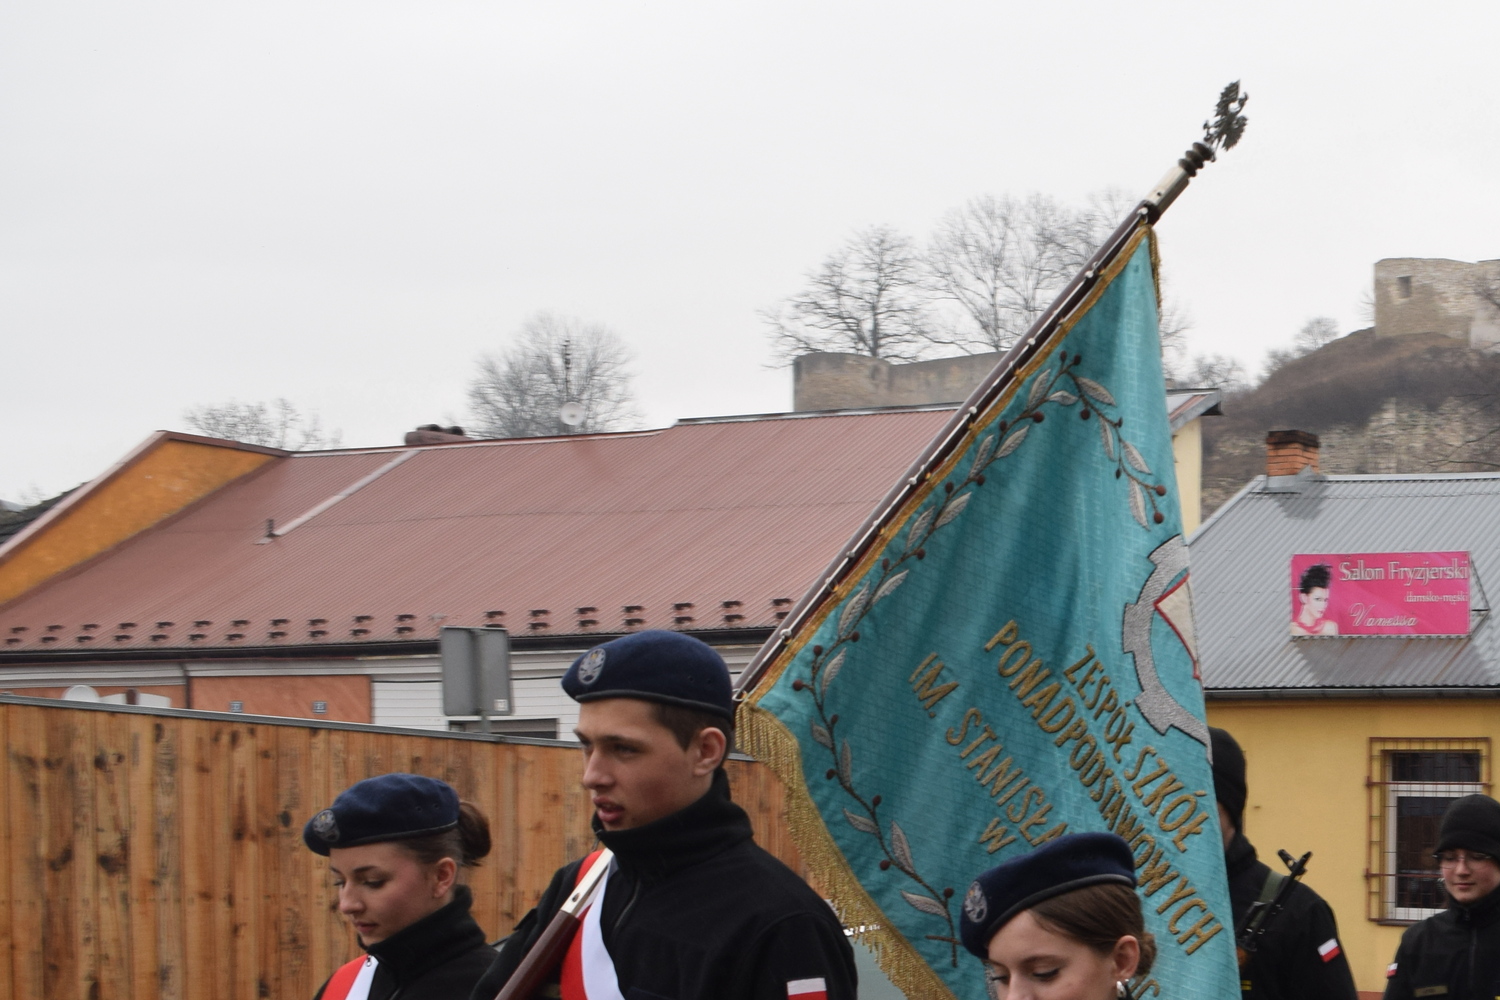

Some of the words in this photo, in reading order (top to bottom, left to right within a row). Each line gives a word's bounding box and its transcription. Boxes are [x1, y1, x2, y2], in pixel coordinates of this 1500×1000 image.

[1338, 559, 1385, 581] Salon
[1387, 558, 1469, 587] Fryzjerski
[1349, 602, 1418, 627] Vanessa
[908, 651, 959, 718] IM.
[945, 707, 1073, 847] STANISŁA
[984, 619, 1223, 956] PONADPODSTAWOWYCH
[1064, 643, 1135, 763] ZESPÓŁ
[1124, 745, 1208, 853] SZKÓŁ
[978, 817, 1017, 854] W
